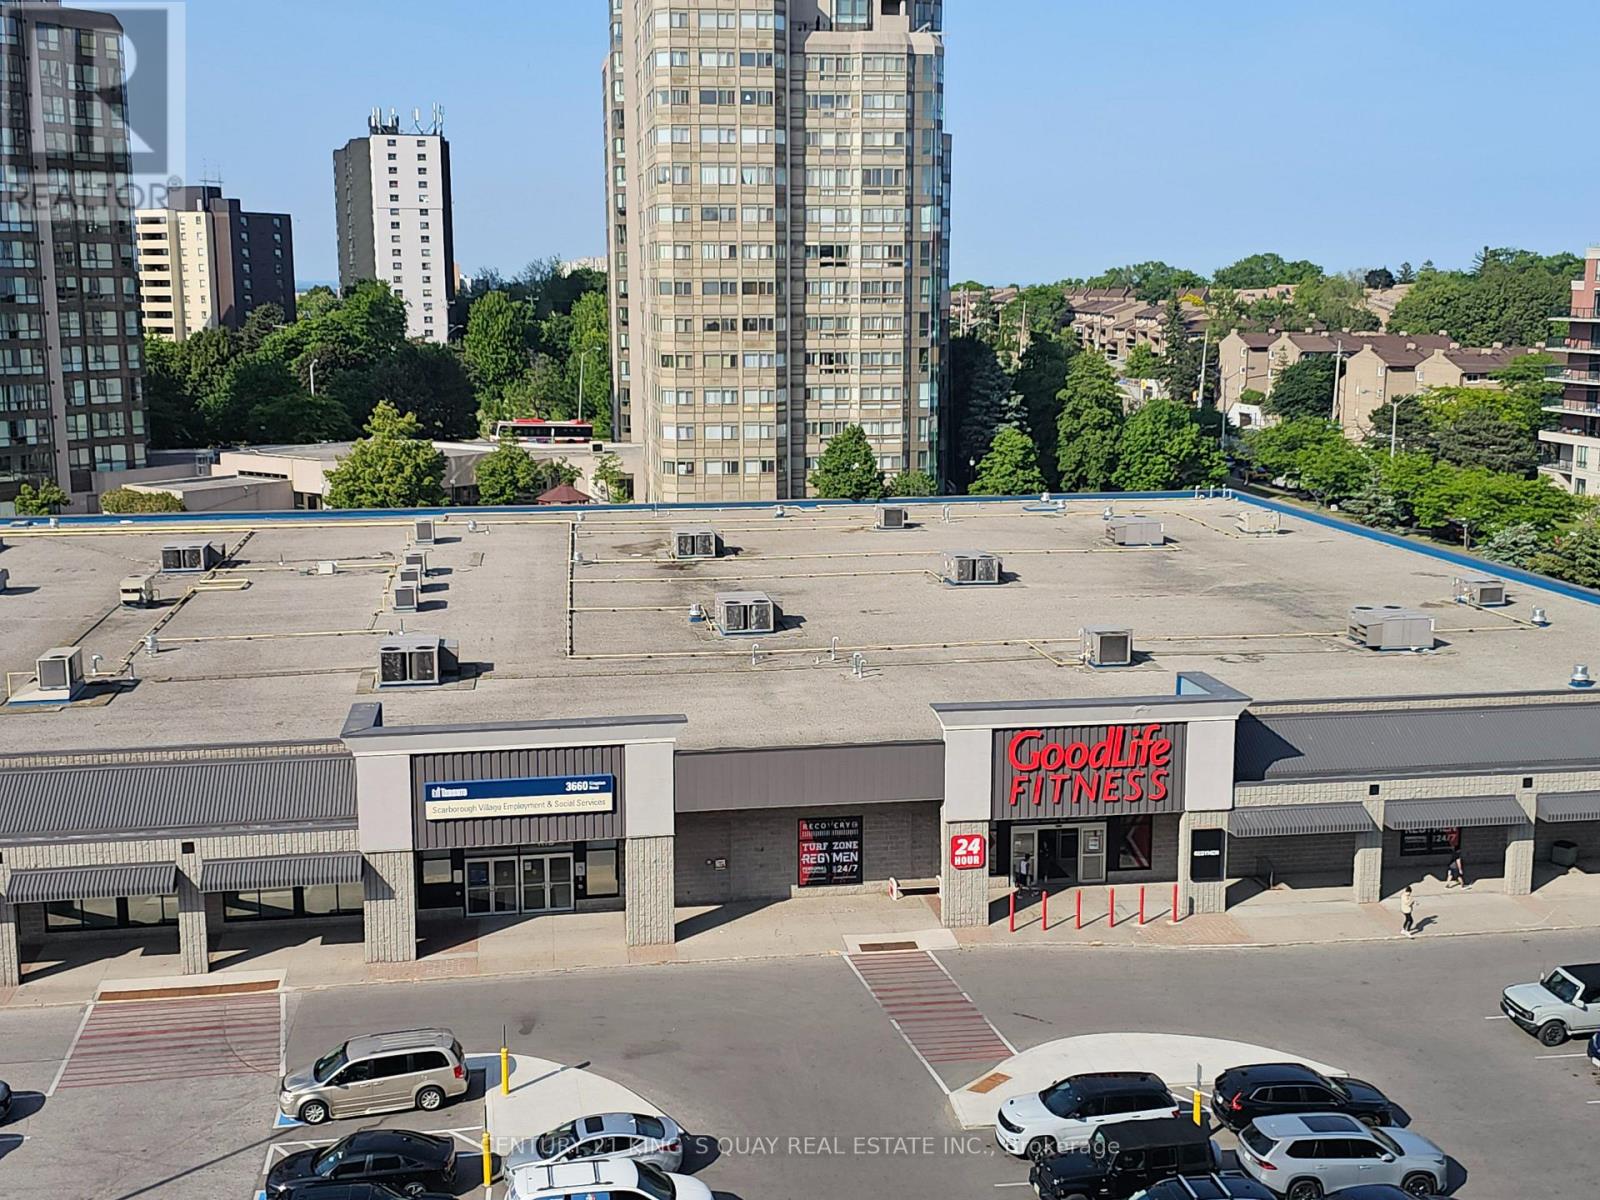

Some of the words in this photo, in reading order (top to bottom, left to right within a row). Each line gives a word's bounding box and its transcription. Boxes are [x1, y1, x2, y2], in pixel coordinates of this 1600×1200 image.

[565, 781, 588, 791] 3660
[1009, 769, 1168, 805] FITNESS
[432, 804, 477, 814] Scarborough
[503, 801, 546, 811] Employment
[554, 800, 575, 808] Social
[576, 799, 606, 807] Services
[802, 842, 828, 851] TURF
[832, 841, 859, 850] ZONE
[955, 837, 981, 855] 24
[954, 855, 980, 865] HOUR
[837, 865, 859, 873] 24/7
